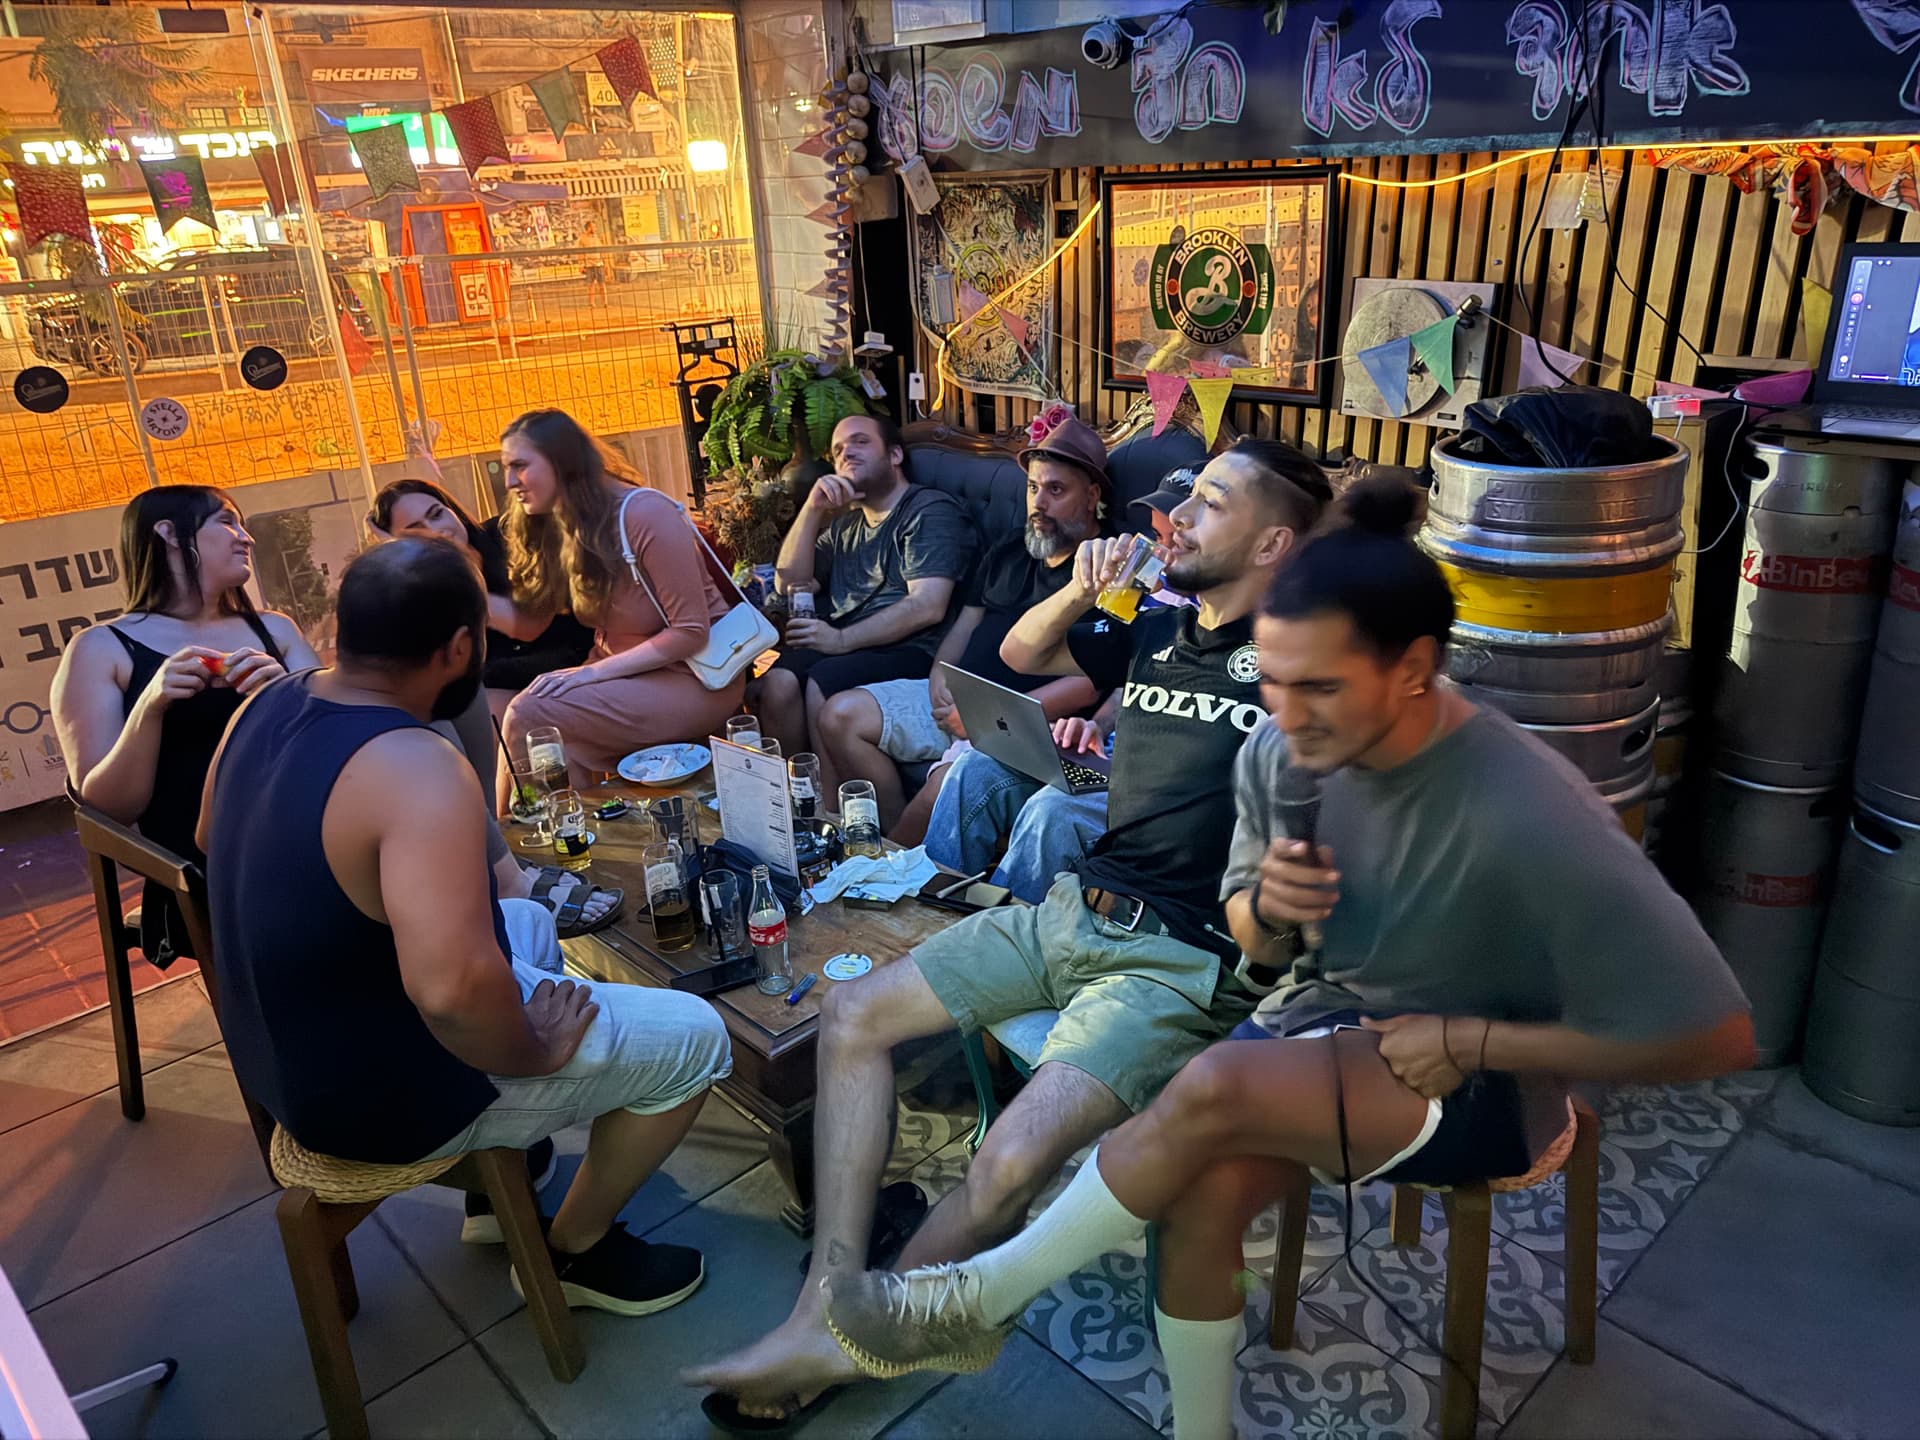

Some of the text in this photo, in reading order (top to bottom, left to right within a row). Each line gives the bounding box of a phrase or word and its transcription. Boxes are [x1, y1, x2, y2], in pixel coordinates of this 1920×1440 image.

[311, 67, 418, 82] SKECHERS
[179, 131, 277, 159] הנכד
[465, 282, 488, 301] 64
[1175, 231, 1249, 344] BROOKLYN BREWERY
[146, 402, 182, 437] STELLA ARTOIS
[1121, 682, 1271, 734] VOLVO
